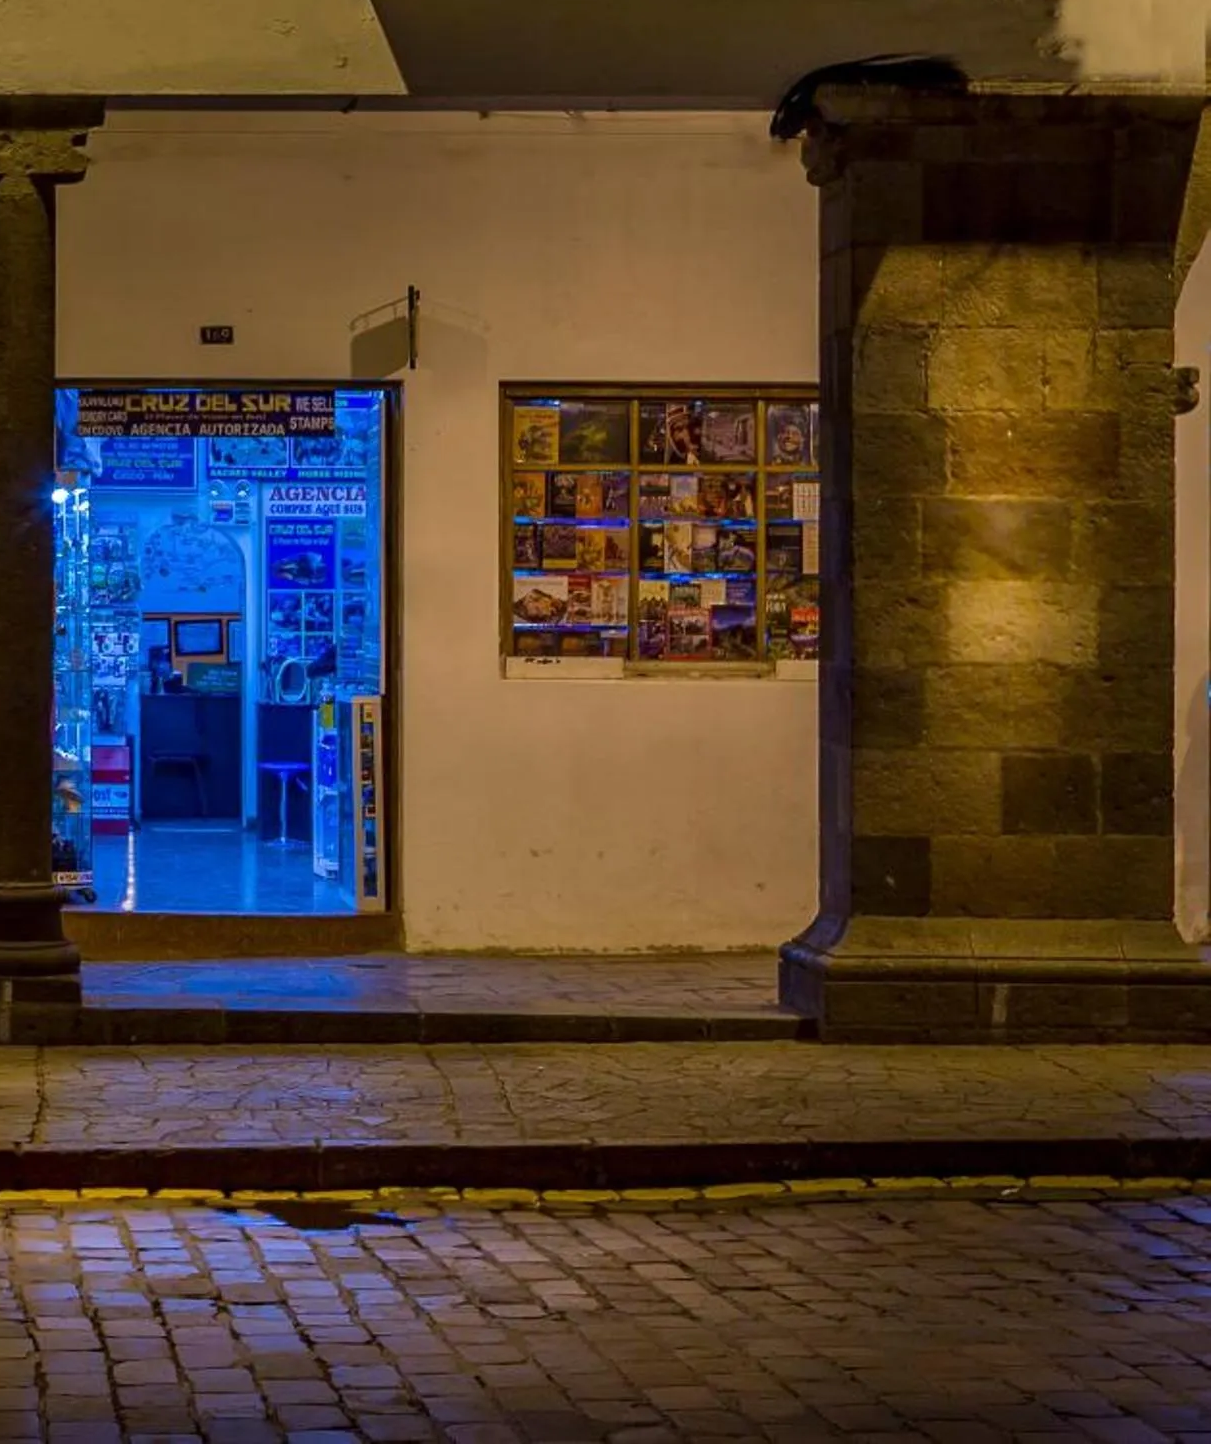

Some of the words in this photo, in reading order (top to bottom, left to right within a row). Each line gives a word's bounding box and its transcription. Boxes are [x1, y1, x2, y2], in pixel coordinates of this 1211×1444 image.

[126, 393, 190, 412] CRUZ
[195, 394, 237, 412] DEL
[241, 394, 292, 412] SUR
[295, 397, 310, 411] WE
[311, 397, 334, 412] SELL
[130, 423, 191, 436] AGENCIA
[199, 423, 286, 436] AUTORIZADA
[269, 485, 366, 502] AGENCIA
